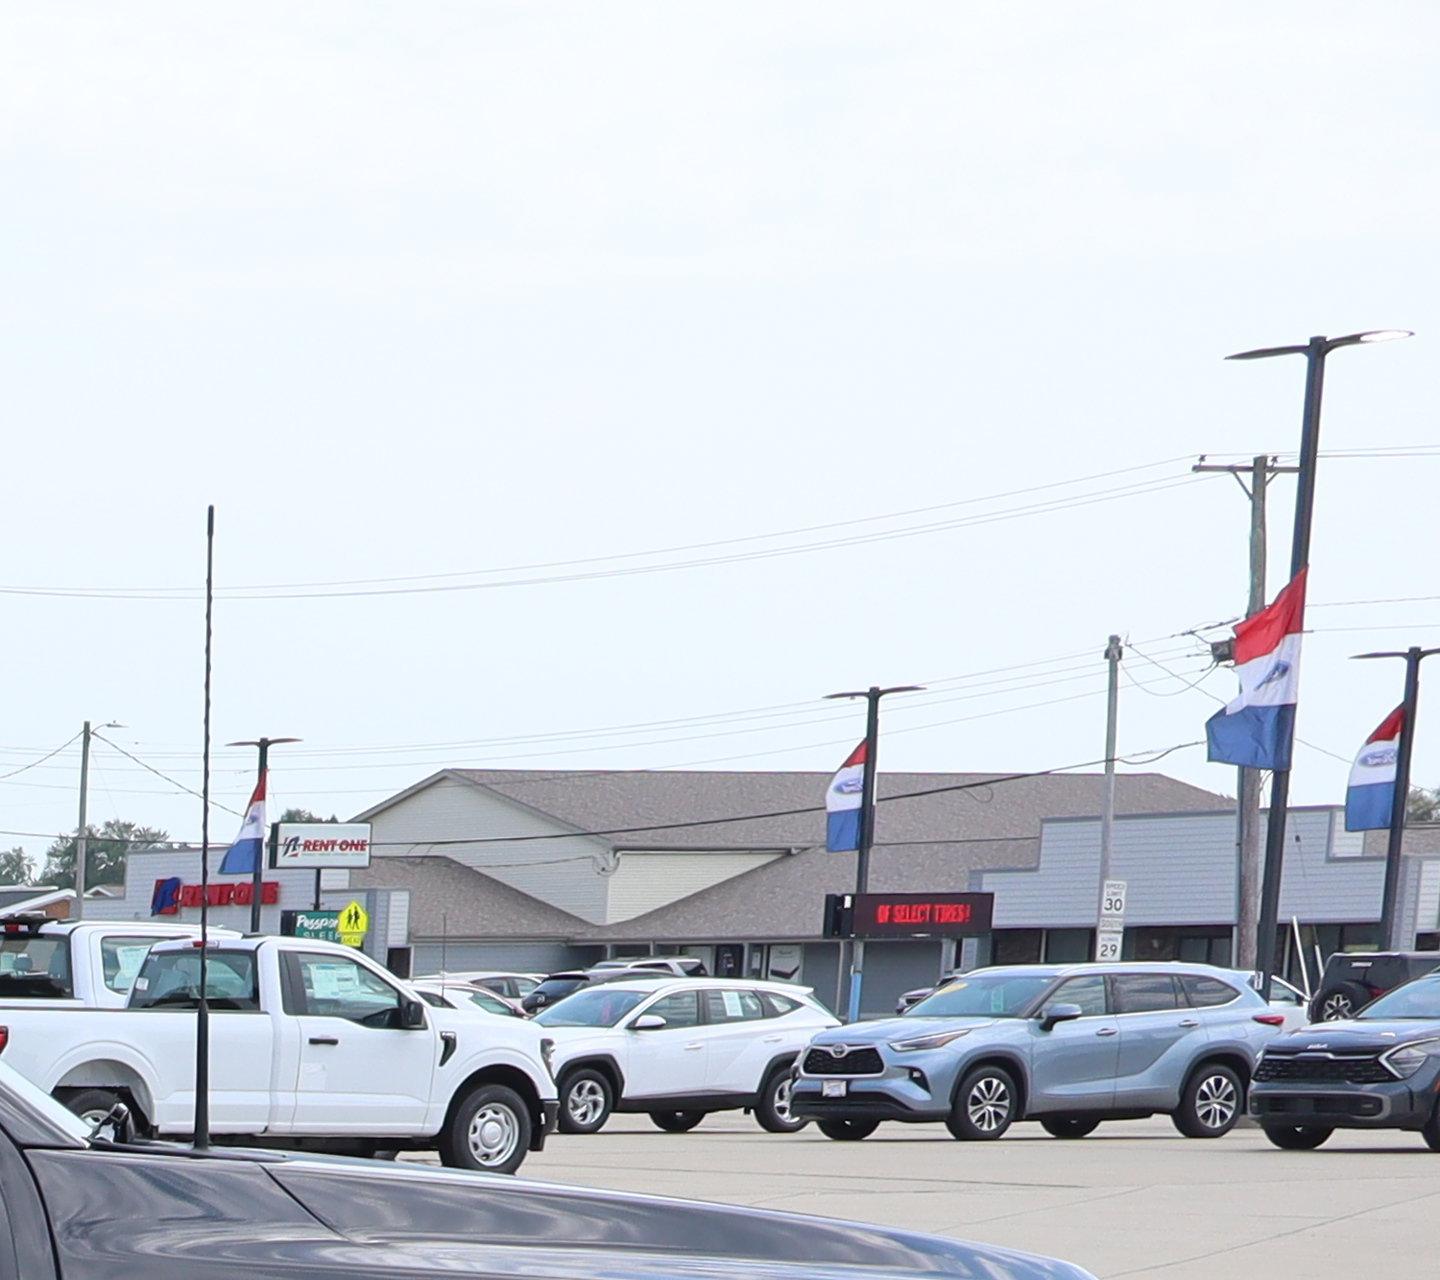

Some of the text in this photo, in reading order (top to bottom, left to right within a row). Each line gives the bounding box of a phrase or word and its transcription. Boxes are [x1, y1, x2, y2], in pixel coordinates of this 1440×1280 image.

[303, 839, 367, 852] RENT ONE
[1104, 898, 1123, 912] 30
[893, 904, 930, 923] SELECT
[296, 914, 339, 930] Passpor
[1100, 943, 1118, 958] 29
